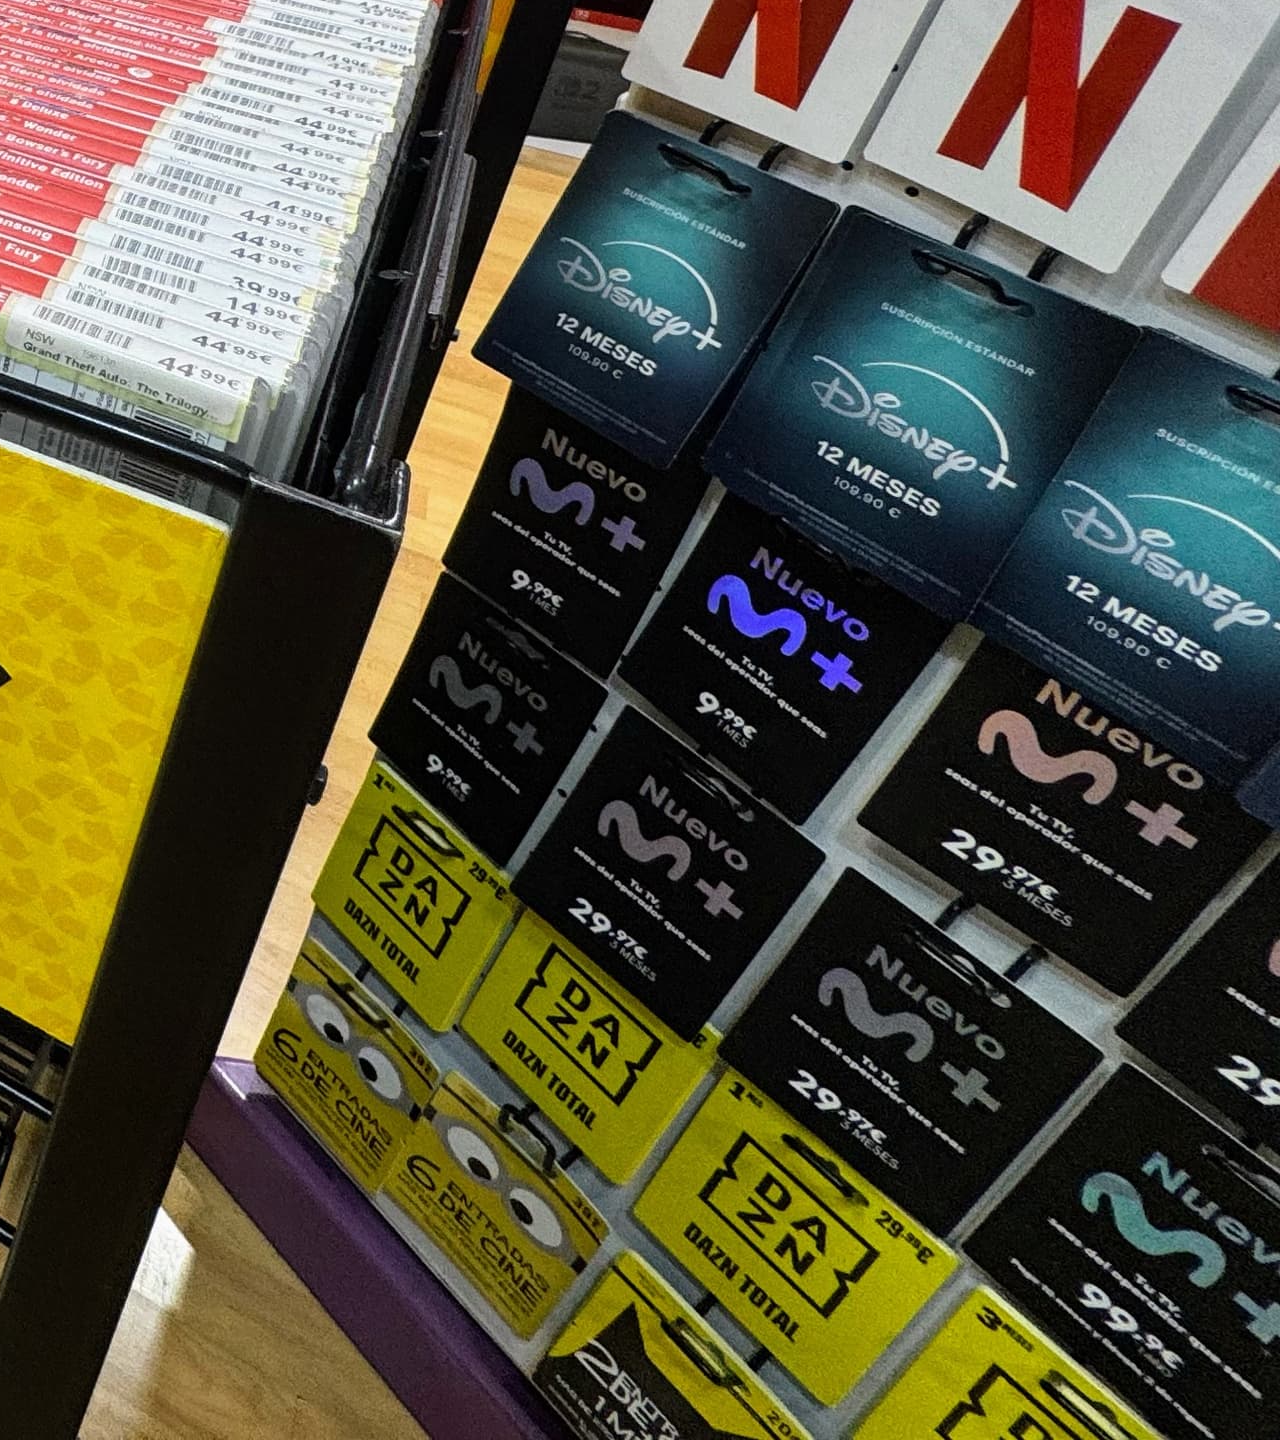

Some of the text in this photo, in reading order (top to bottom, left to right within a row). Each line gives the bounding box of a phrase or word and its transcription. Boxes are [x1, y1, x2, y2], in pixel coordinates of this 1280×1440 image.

[24, 327, 57, 347] NSW
[555, 312, 657, 378] 12 MESES
[540, 428, 647, 503] Nuevo
[816, 440, 941, 518] 12 MESES
[749, 547, 870, 642] Nuevo
[1065, 575, 1223, 672] 12 MESES
[457, 632, 548, 713] Nuevo
[1035, 678, 1204, 790] Nuevo
[639, 774, 748, 871] Nuevo
[344, 900, 419, 985] DAZN TOTAL
[866, 943, 1005, 1059] Nuevo
[503, 1029, 597, 1131] DAZN TOTAL
[334, 1099, 385, 1160] CINE
[438, 1191, 538, 1302] DE CINE
[683, 1222, 801, 1344] DAZN TOTAL
